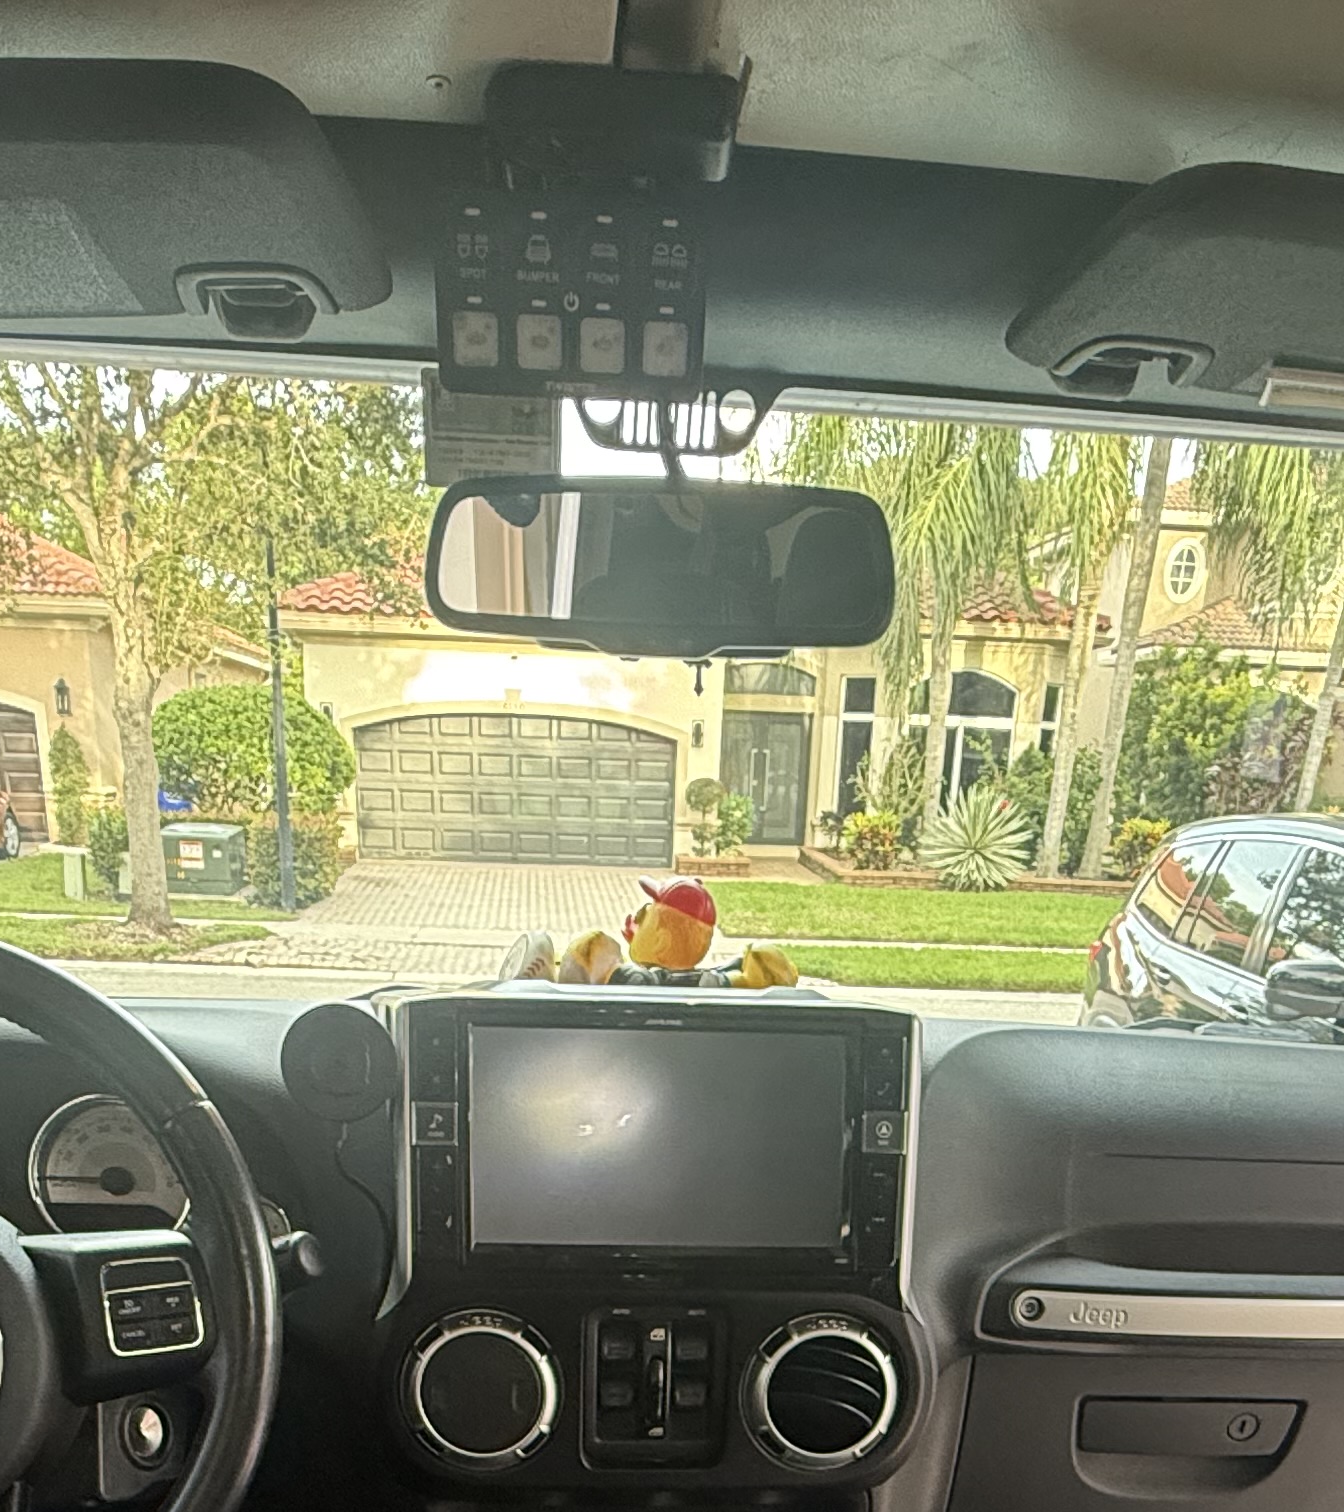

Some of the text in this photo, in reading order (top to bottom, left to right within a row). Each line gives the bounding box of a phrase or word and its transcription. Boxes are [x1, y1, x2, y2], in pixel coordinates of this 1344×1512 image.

[459, 268, 488, 280] SPOT
[516, 269, 560, 283] BUMPER
[585, 271, 622, 286] FRONT
[654, 278, 683, 291] REAR
[1069, 1301, 1129, 1329] Jeep
